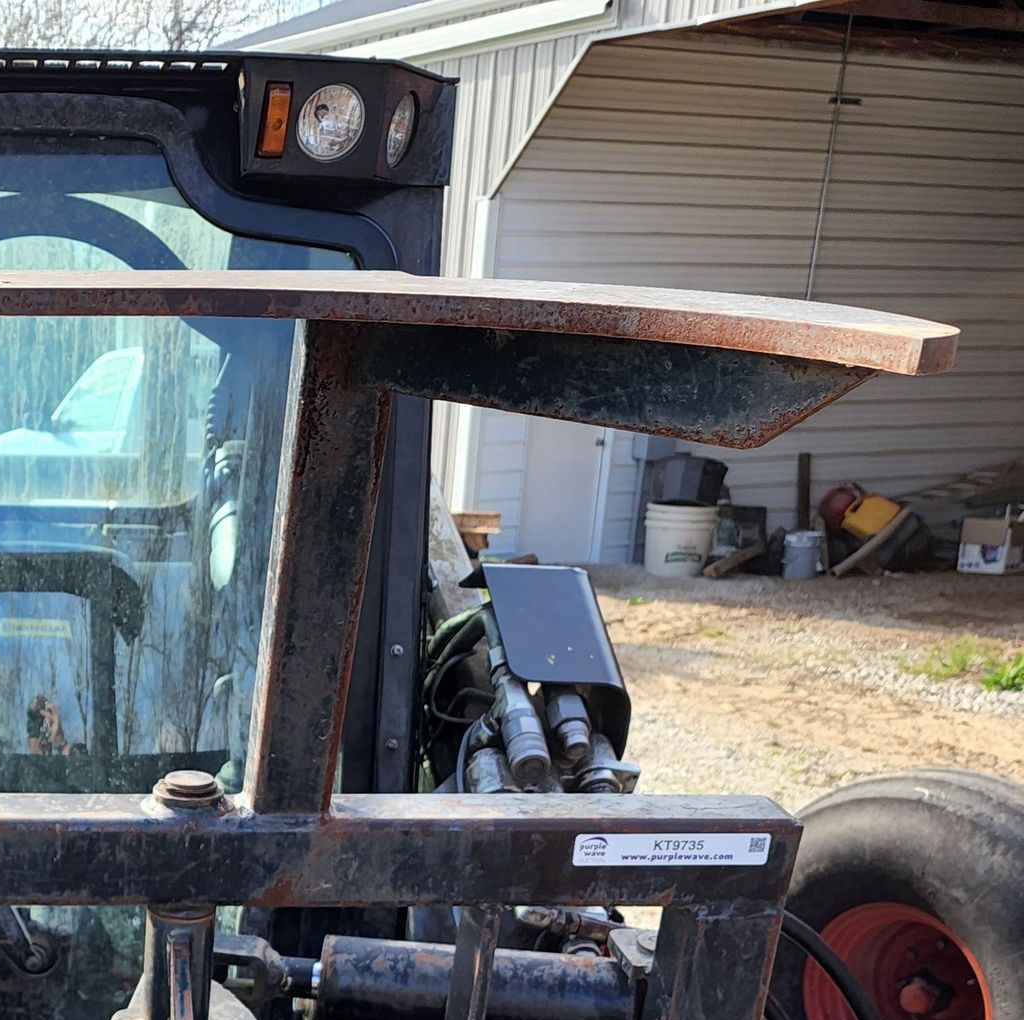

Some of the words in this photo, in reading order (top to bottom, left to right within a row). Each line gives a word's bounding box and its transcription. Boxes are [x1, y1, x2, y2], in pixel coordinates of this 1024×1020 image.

[579, 843, 607, 851] purple
[653, 840, 704, 850] KT9735
[621, 853, 734, 862] www.purplewave.com
